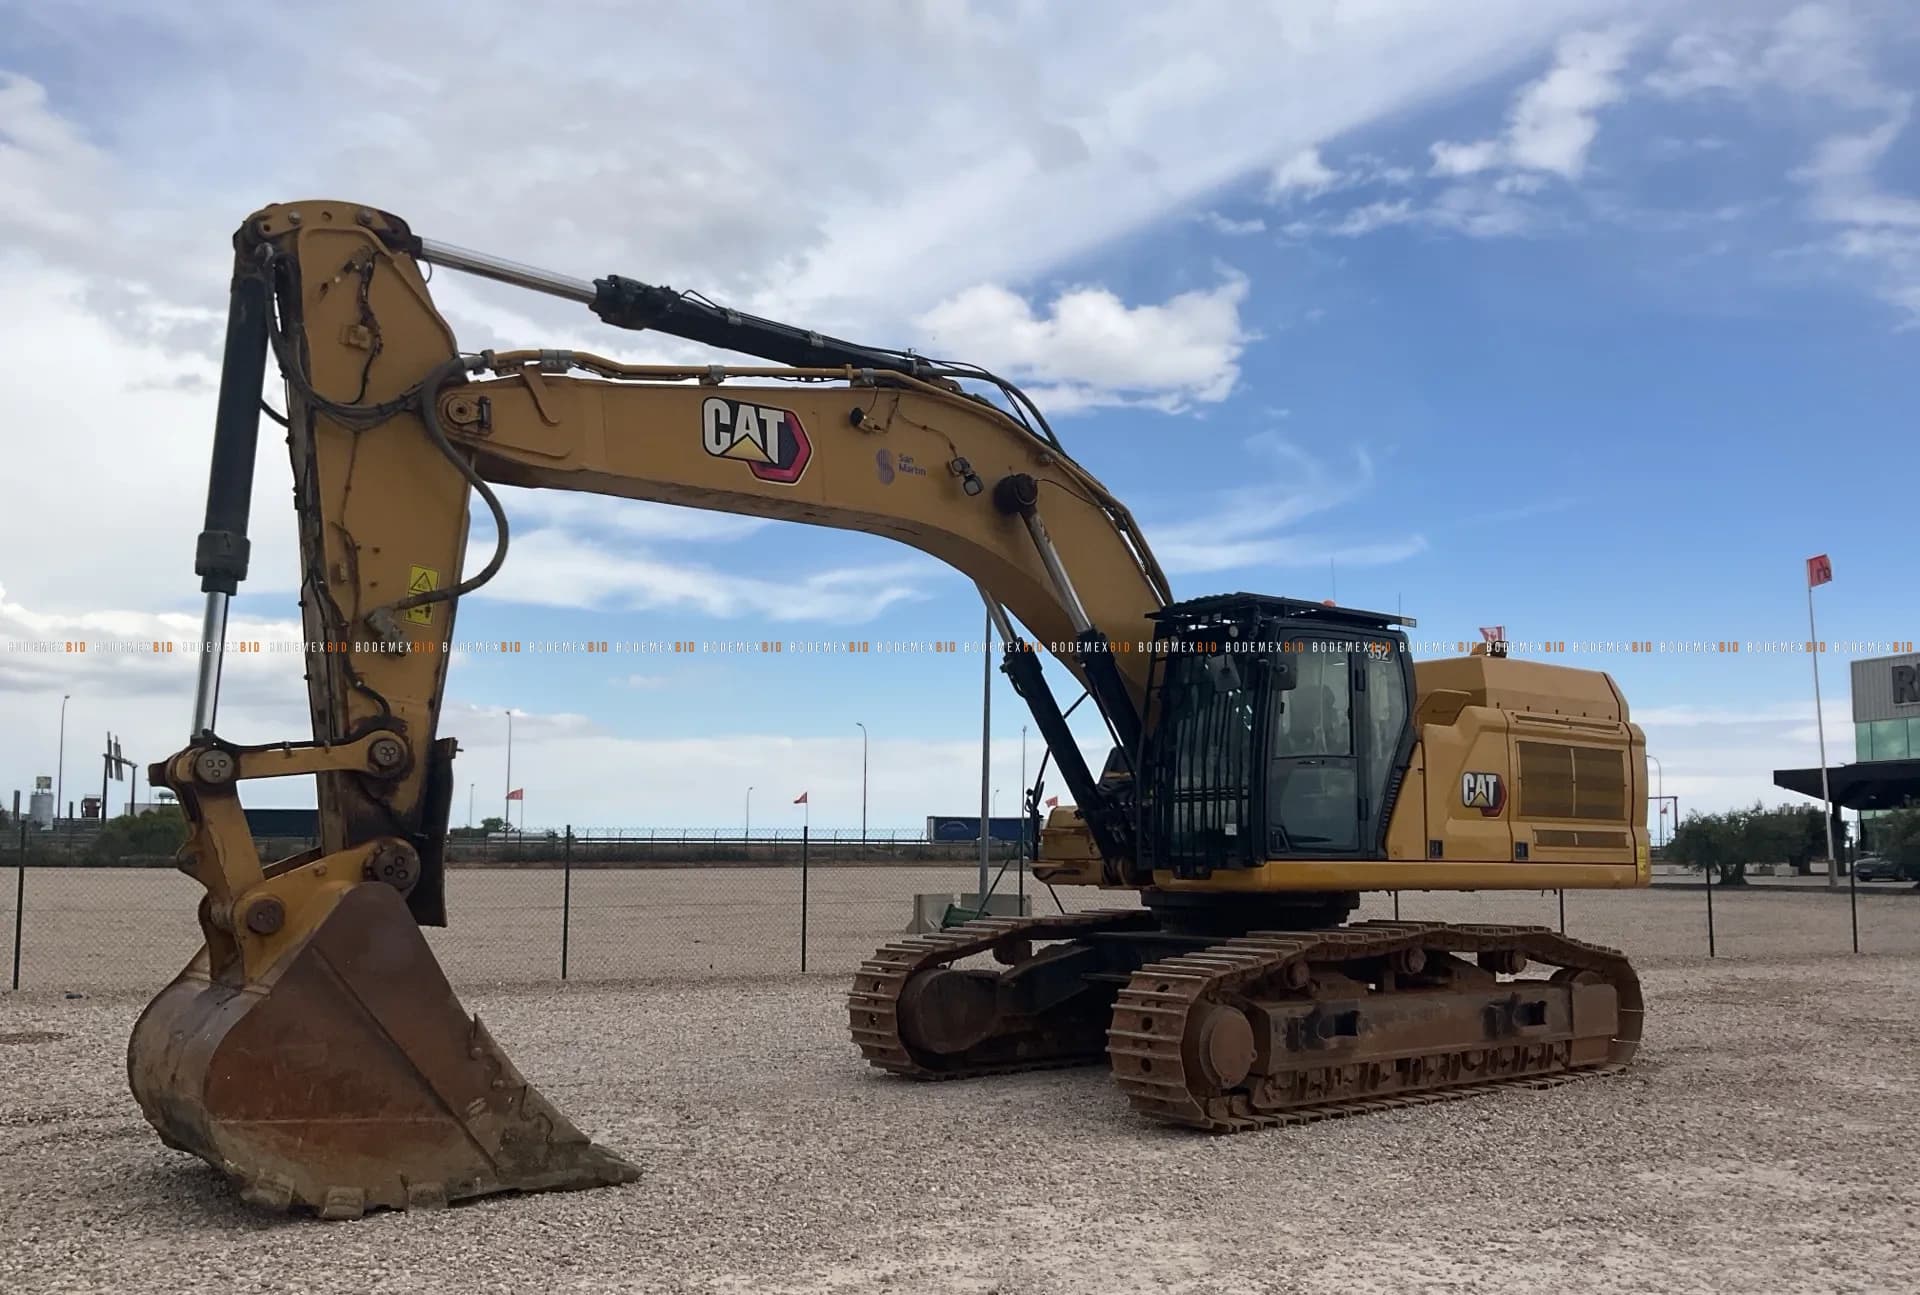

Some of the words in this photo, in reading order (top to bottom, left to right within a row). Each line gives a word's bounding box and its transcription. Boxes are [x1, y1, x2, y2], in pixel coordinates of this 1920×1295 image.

[704, 398, 784, 464] CAT
[1368, 643, 1390, 661] 352
[1463, 772, 1497, 807] CAT
